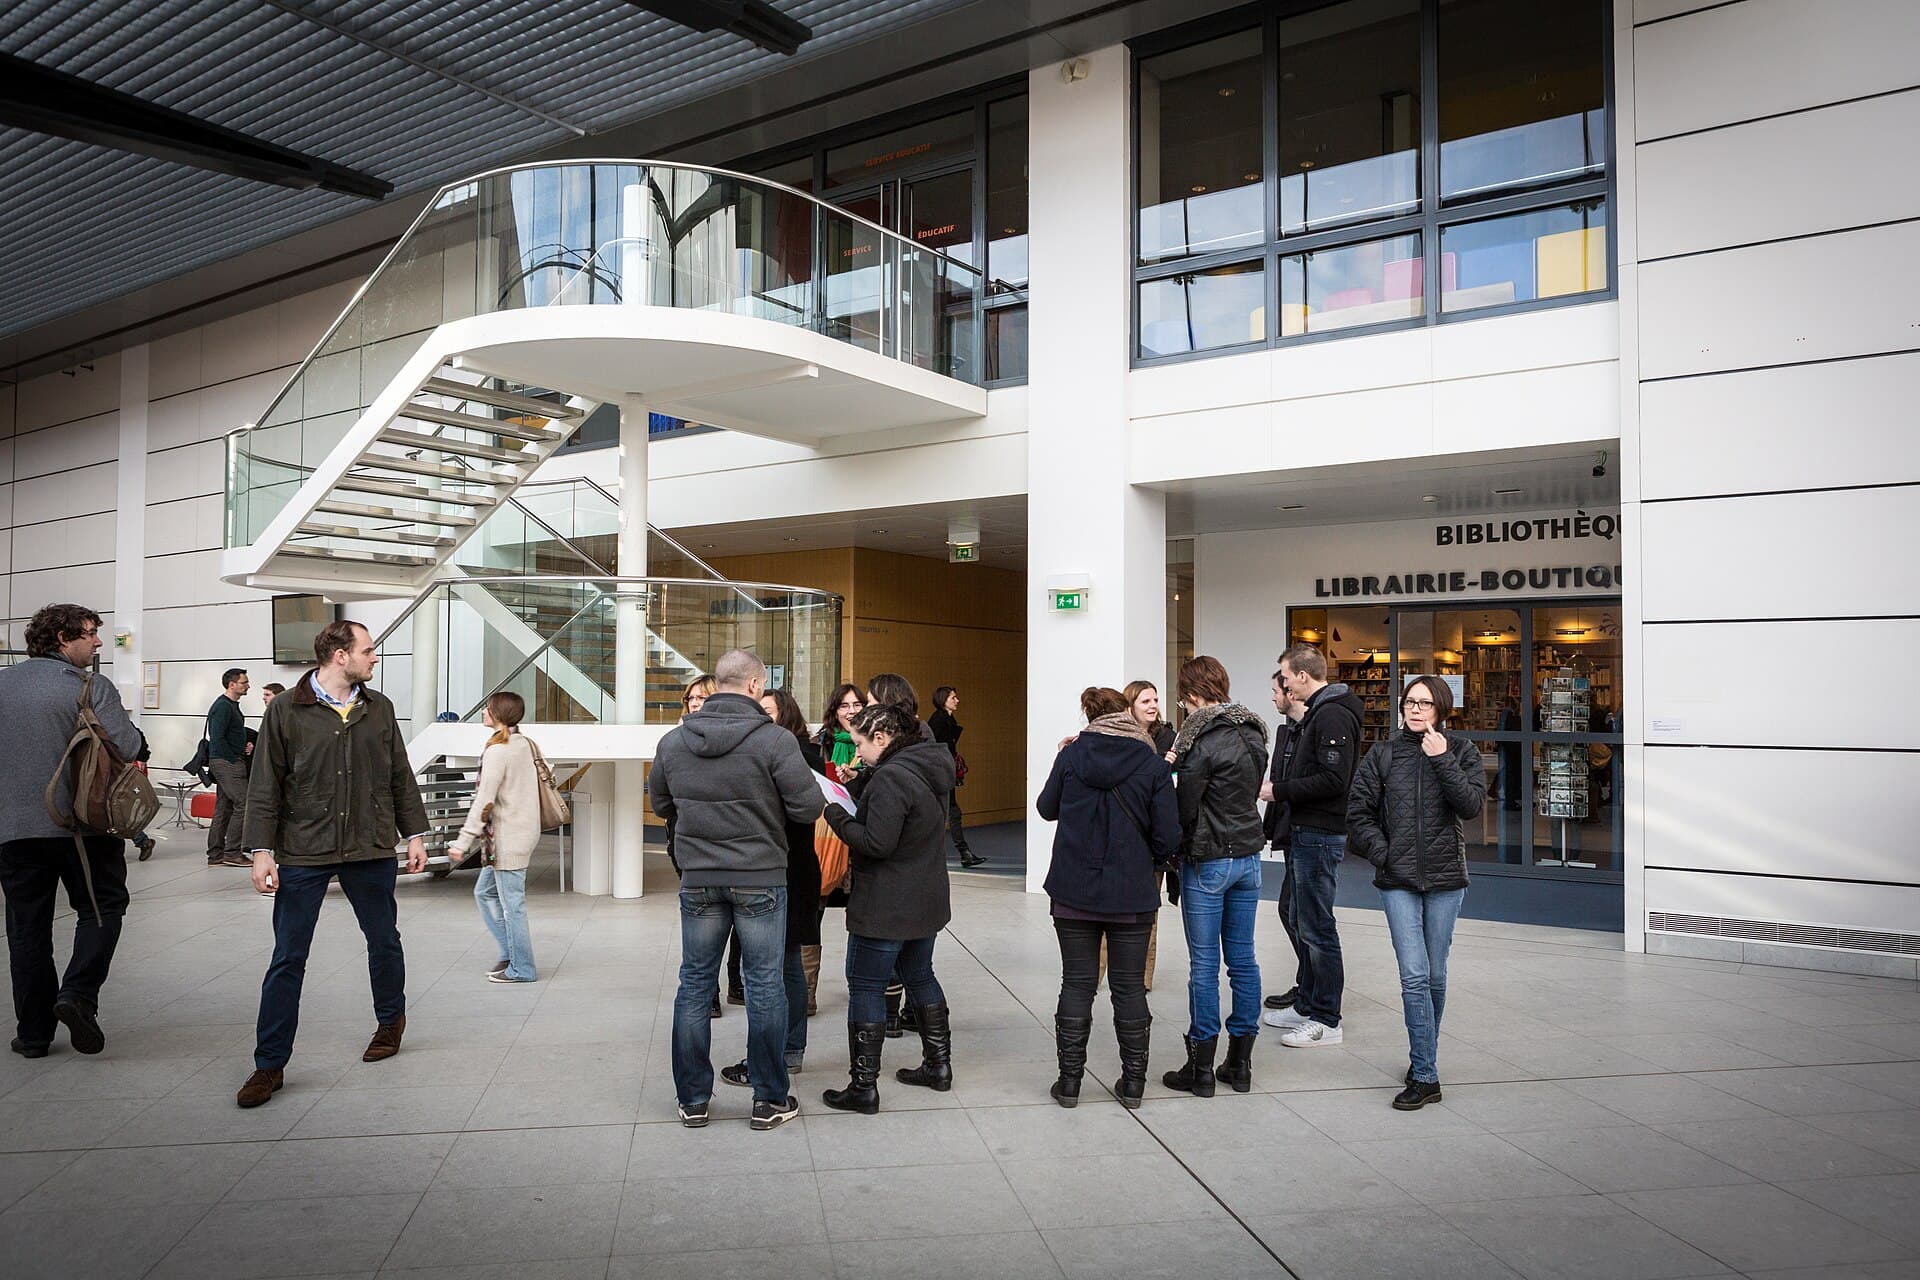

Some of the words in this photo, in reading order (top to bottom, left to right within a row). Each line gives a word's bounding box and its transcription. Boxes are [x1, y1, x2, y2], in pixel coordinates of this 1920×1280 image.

[843, 244, 872, 257] SERVICE
[917, 224, 955, 239] ÉDUCATIF
[1436, 509, 1621, 546] BIBLIOTHÈQ
